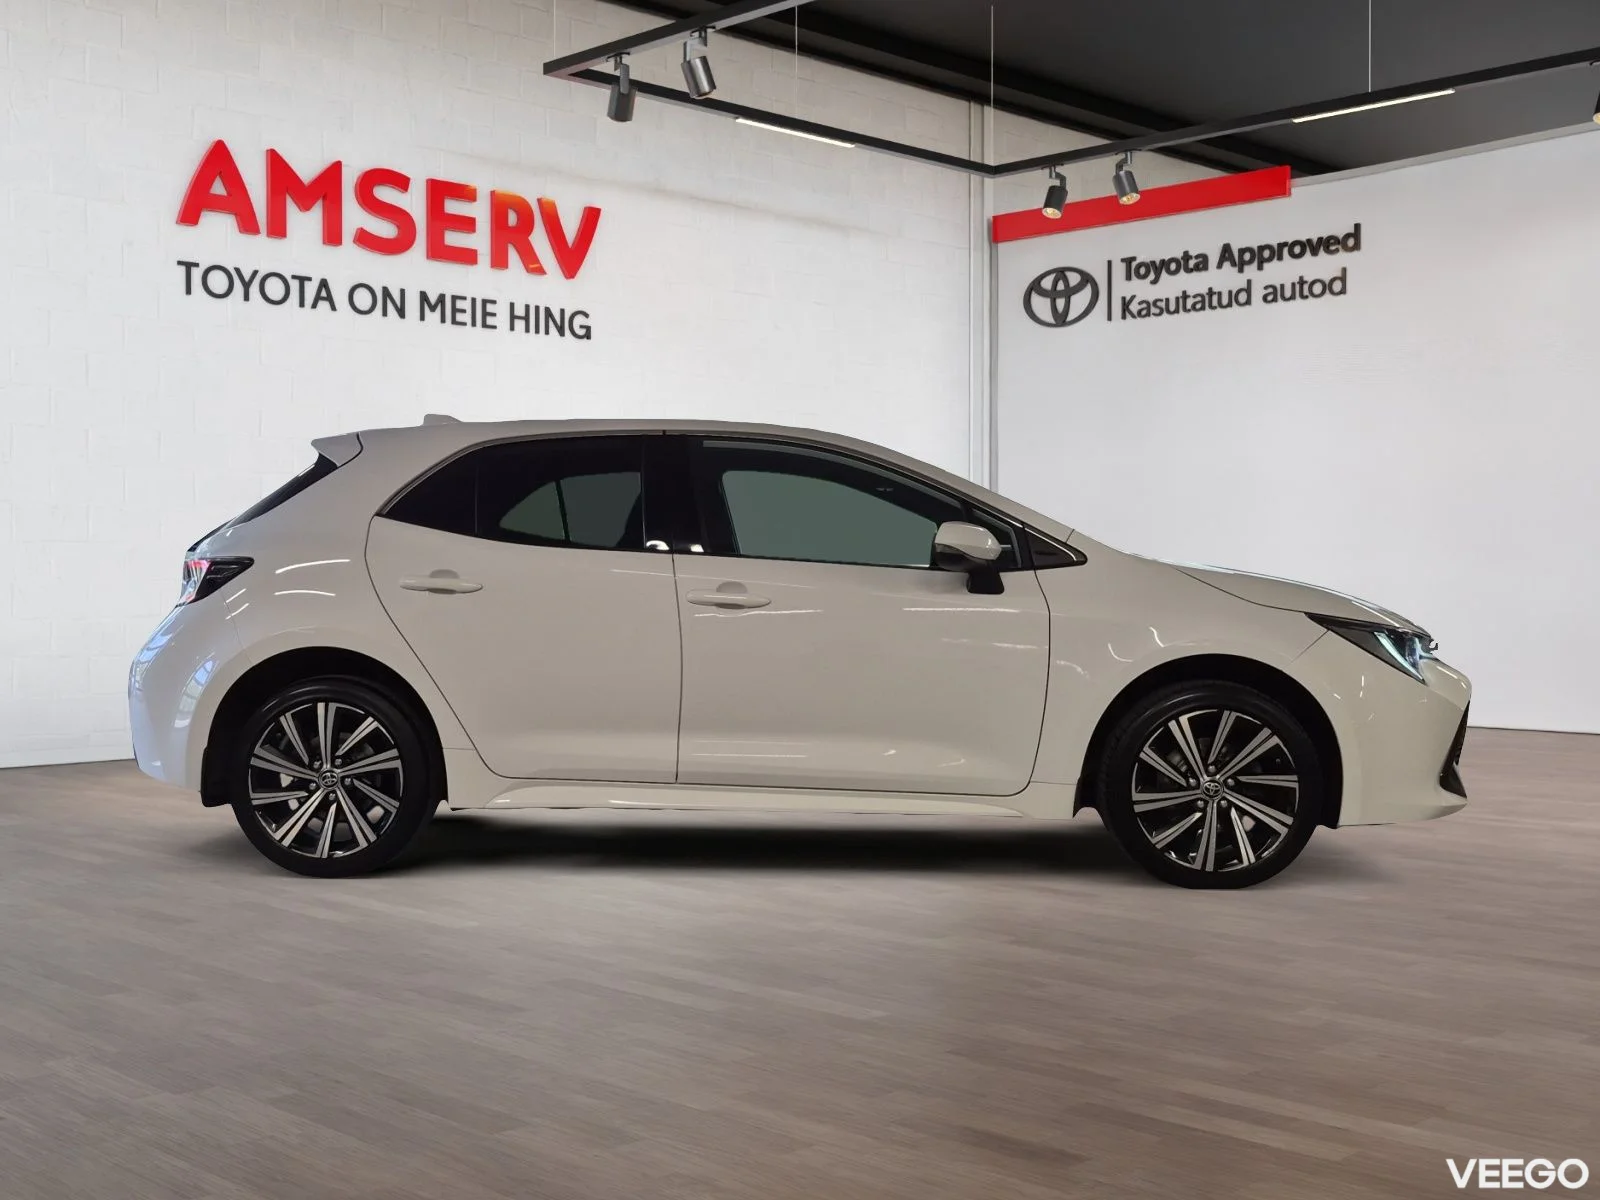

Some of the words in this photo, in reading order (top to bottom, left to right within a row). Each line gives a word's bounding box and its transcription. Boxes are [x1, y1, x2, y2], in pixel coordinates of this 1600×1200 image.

[176, 139, 601, 280] AMSERV
[1121, 250, 1208, 285] Toyota
[1216, 223, 1361, 274] Approved
[176, 260, 337, 312] TOYOTA
[348, 282, 406, 319] ON
[419, 290, 497, 329] MEIE
[509, 302, 592, 340] HING
[1120, 279, 1252, 320] Kasutatud
[1262, 267, 1347, 304] autod
